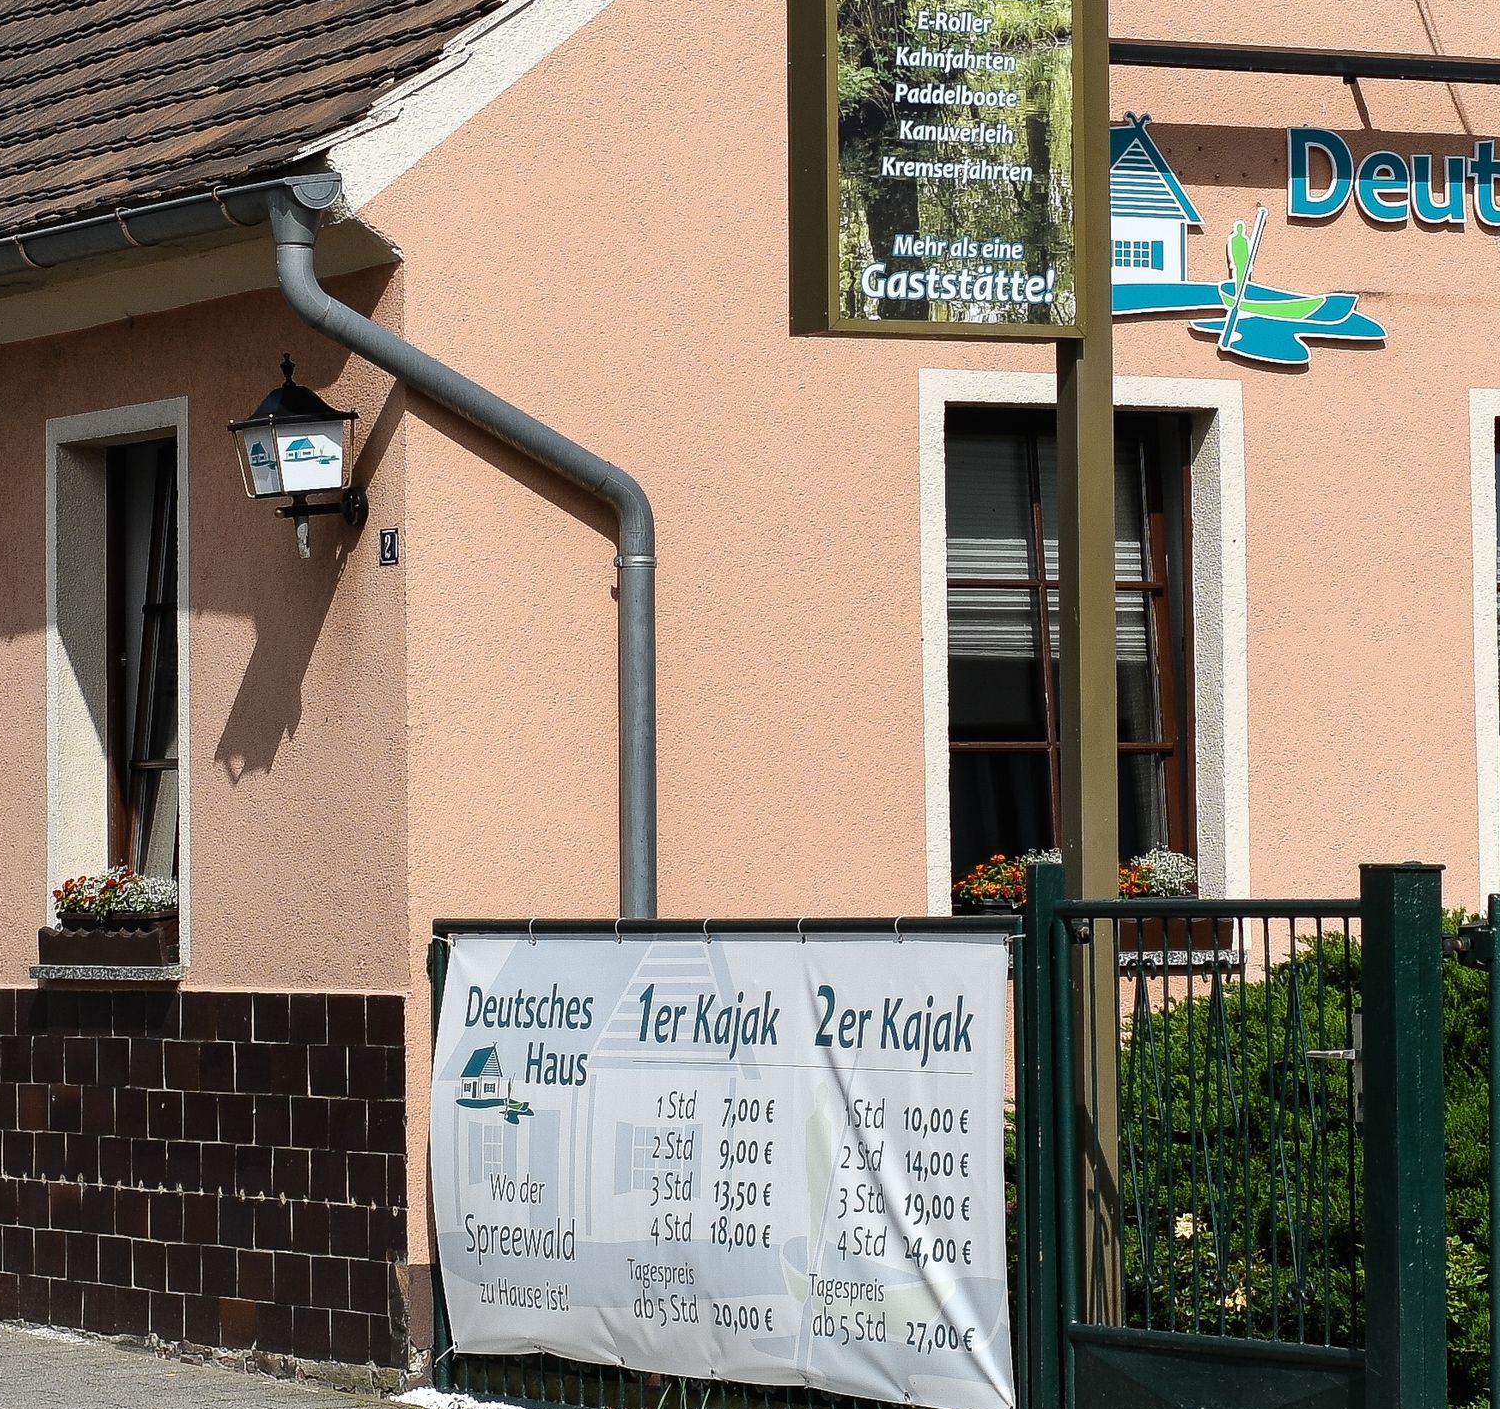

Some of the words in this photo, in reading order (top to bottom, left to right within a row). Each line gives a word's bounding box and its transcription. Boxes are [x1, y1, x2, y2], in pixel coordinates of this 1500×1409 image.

[917, 10, 993, 34] E-Roller
[895, 46, 1016, 74] Kahnfahrten
[894, 83, 1018, 108] Paddelboote
[899, 119, 1014, 145] Kanuverleih
[881, 156, 1033, 185] Kremserfahrten
[893, 233, 947, 258] Mehr
[950, 237, 977, 258] als
[982, 238, 1024, 260] eine
[861, 262, 1056, 304] Gaststätte!
[464, 983, 594, 1030] Deutsches
[638, 983, 688, 1044] 1er
[692, 990, 781, 1061] Kajak
[814, 984, 873, 1049] 2er
[880, 995, 975, 1068] Kajak
[525, 1041, 588, 1087] Haus
[657, 1095, 663, 1119] 1
[666, 1089, 698, 1120] Std
[722, 1097, 760, 1128] 7,00
[765, 1098, 775, 1124] €
[853, 1097, 886, 1130] Std
[903, 1106, 954, 1140] 10,00
[959, 1108, 969, 1134] €
[652, 1135, 661, 1159] 2
[665, 1130, 695, 1161] Std
[719, 1139, 759, 1170] 9,00
[764, 1141, 773, 1165] €
[840, 1145, 851, 1169] 2
[857, 1140, 885, 1172] Std
[905, 1149, 954, 1182] 14,00
[959, 1152, 969, 1178] €
[489, 1173, 516, 1203] Wo
[519, 1173, 546, 1205] der
[650, 1176, 660, 1207] 3
[664, 1170, 693, 1202] Std
[713, 1180, 757, 1211] 13,50
[762, 1182, 772, 1207] €
[837, 1187, 848, 1219] 3
[853, 1183, 886, 1215] Std
[904, 1192, 955, 1226] 19,00
[961, 1196, 970, 1222] €
[464, 1213, 576, 1266] Spreewald
[650, 1217, 660, 1247] 4
[664, 1212, 692, 1243] Std
[710, 1215, 756, 1253] 18,00
[761, 1224, 771, 1249] €
[837, 1230, 848, 1261] 4
[853, 1225, 888, 1258] Std
[902, 1235, 957, 1270] 24,00
[962, 1239, 972, 1266] €
[627, 1257, 695, 1290] Tagespreis
[808, 1273, 885, 1307] Tagespreis
[479, 1283, 495, 1304] zu
[498, 1278, 543, 1309] Hause
[546, 1281, 570, 1312] ist!
[633, 1289, 654, 1319] ab
[658, 1297, 667, 1327] 5
[670, 1294, 700, 1324] Std
[712, 1302, 760, 1335] 20,00
[764, 1307, 773, 1333] €
[812, 1306, 835, 1338] ab
[840, 1315, 850, 1346] 5
[855, 1311, 887, 1343] Std
[906, 1321, 959, 1355] 27,00
[962, 1327, 976, 1352] €
